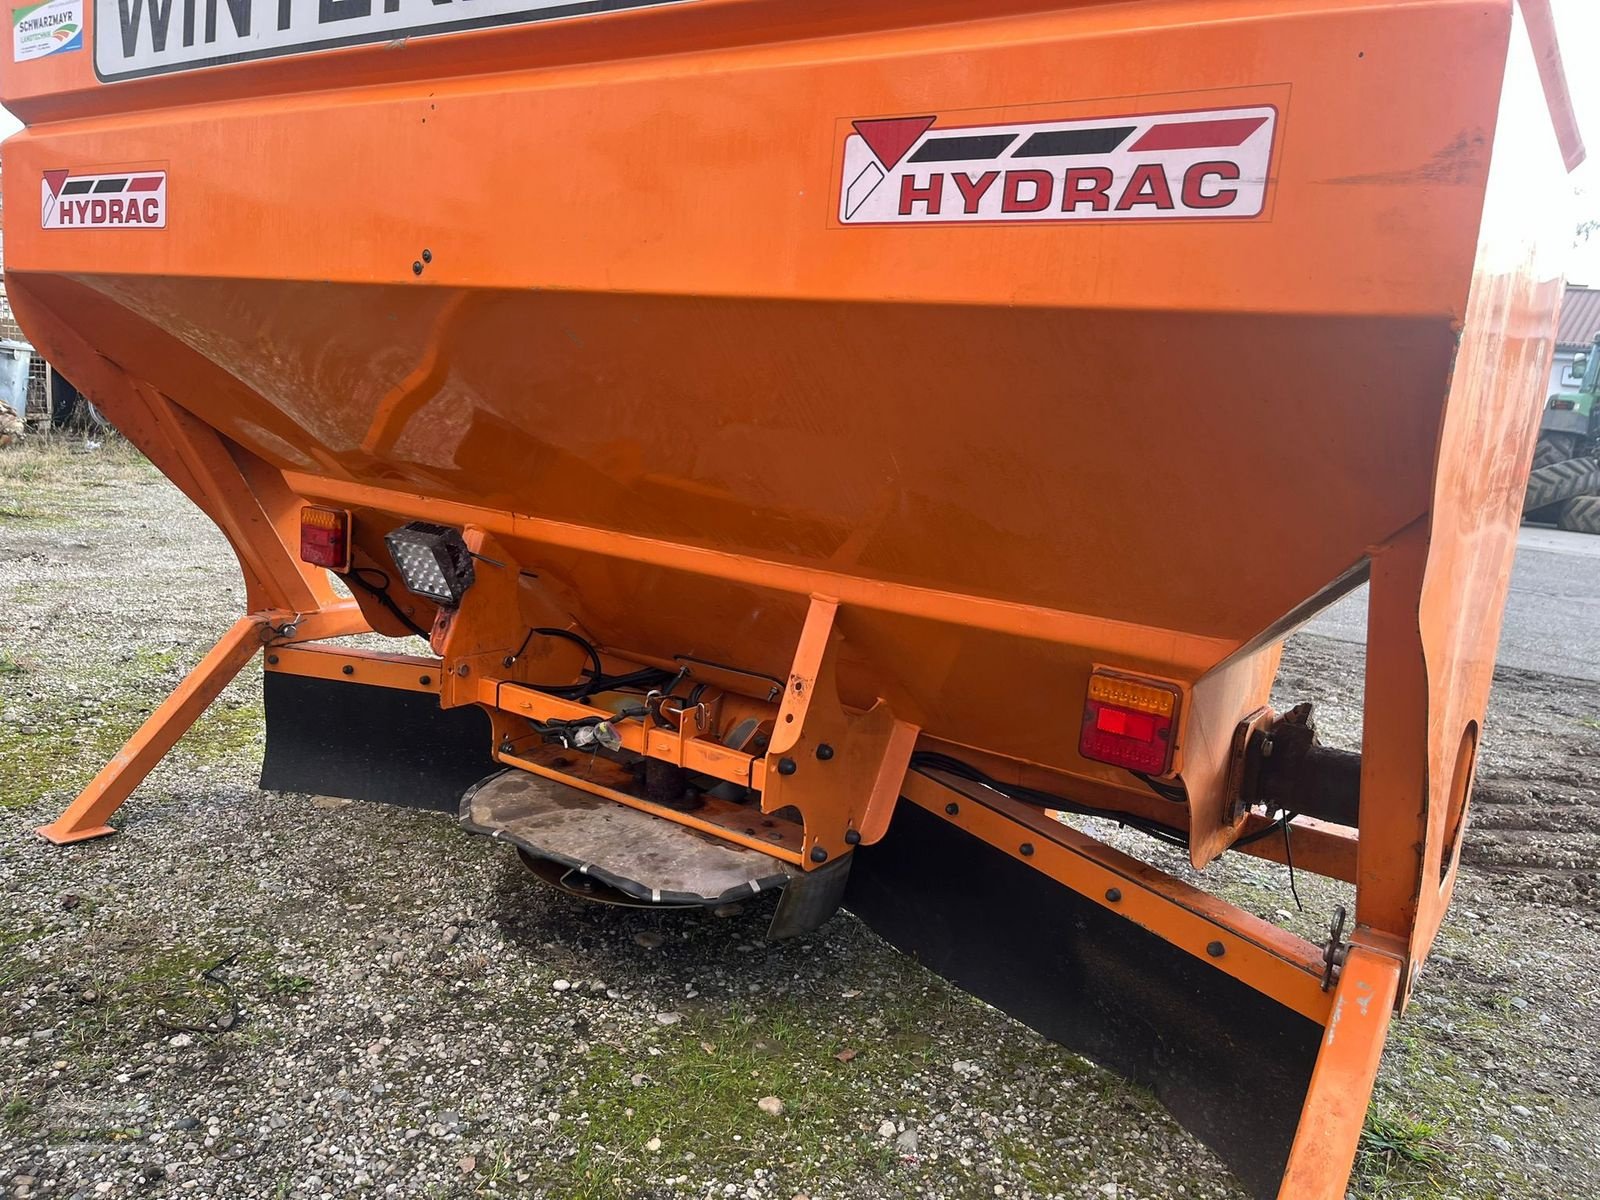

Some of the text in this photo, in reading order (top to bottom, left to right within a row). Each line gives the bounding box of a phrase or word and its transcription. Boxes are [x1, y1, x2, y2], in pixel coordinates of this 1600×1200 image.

[19, 11, 73, 33] SCHWARZMAYR
[897, 160, 1241, 216] HYDRAC
[59, 197, 159, 225] HYDRAC
